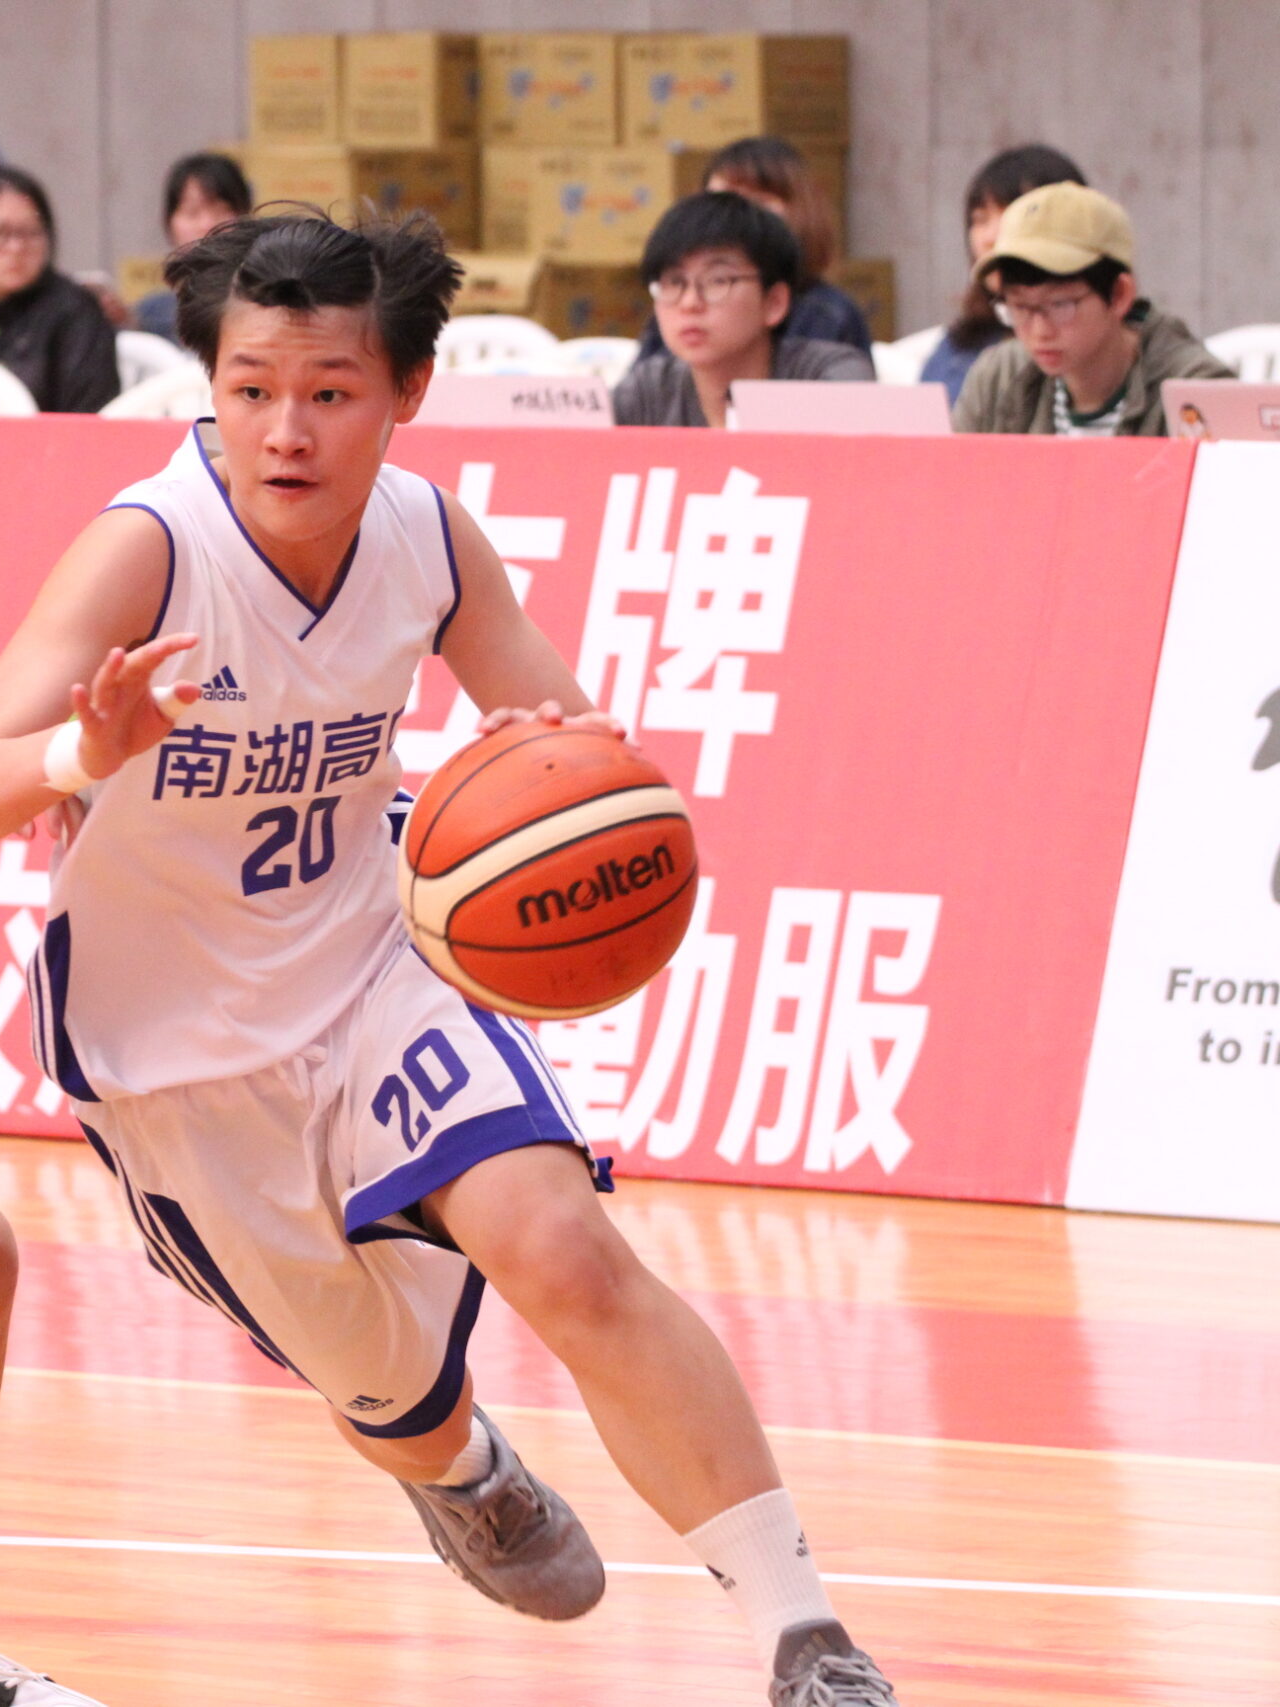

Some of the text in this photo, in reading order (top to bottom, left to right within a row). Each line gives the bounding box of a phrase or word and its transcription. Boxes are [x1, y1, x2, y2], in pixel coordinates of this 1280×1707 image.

[199, 687, 247, 702] didas
[240, 795, 342, 897] 20
[517, 842, 675, 928] molten
[1165, 966, 1280, 1006] From
[1199, 1029, 1243, 1064] to
[370, 1027, 472, 1153] 20
